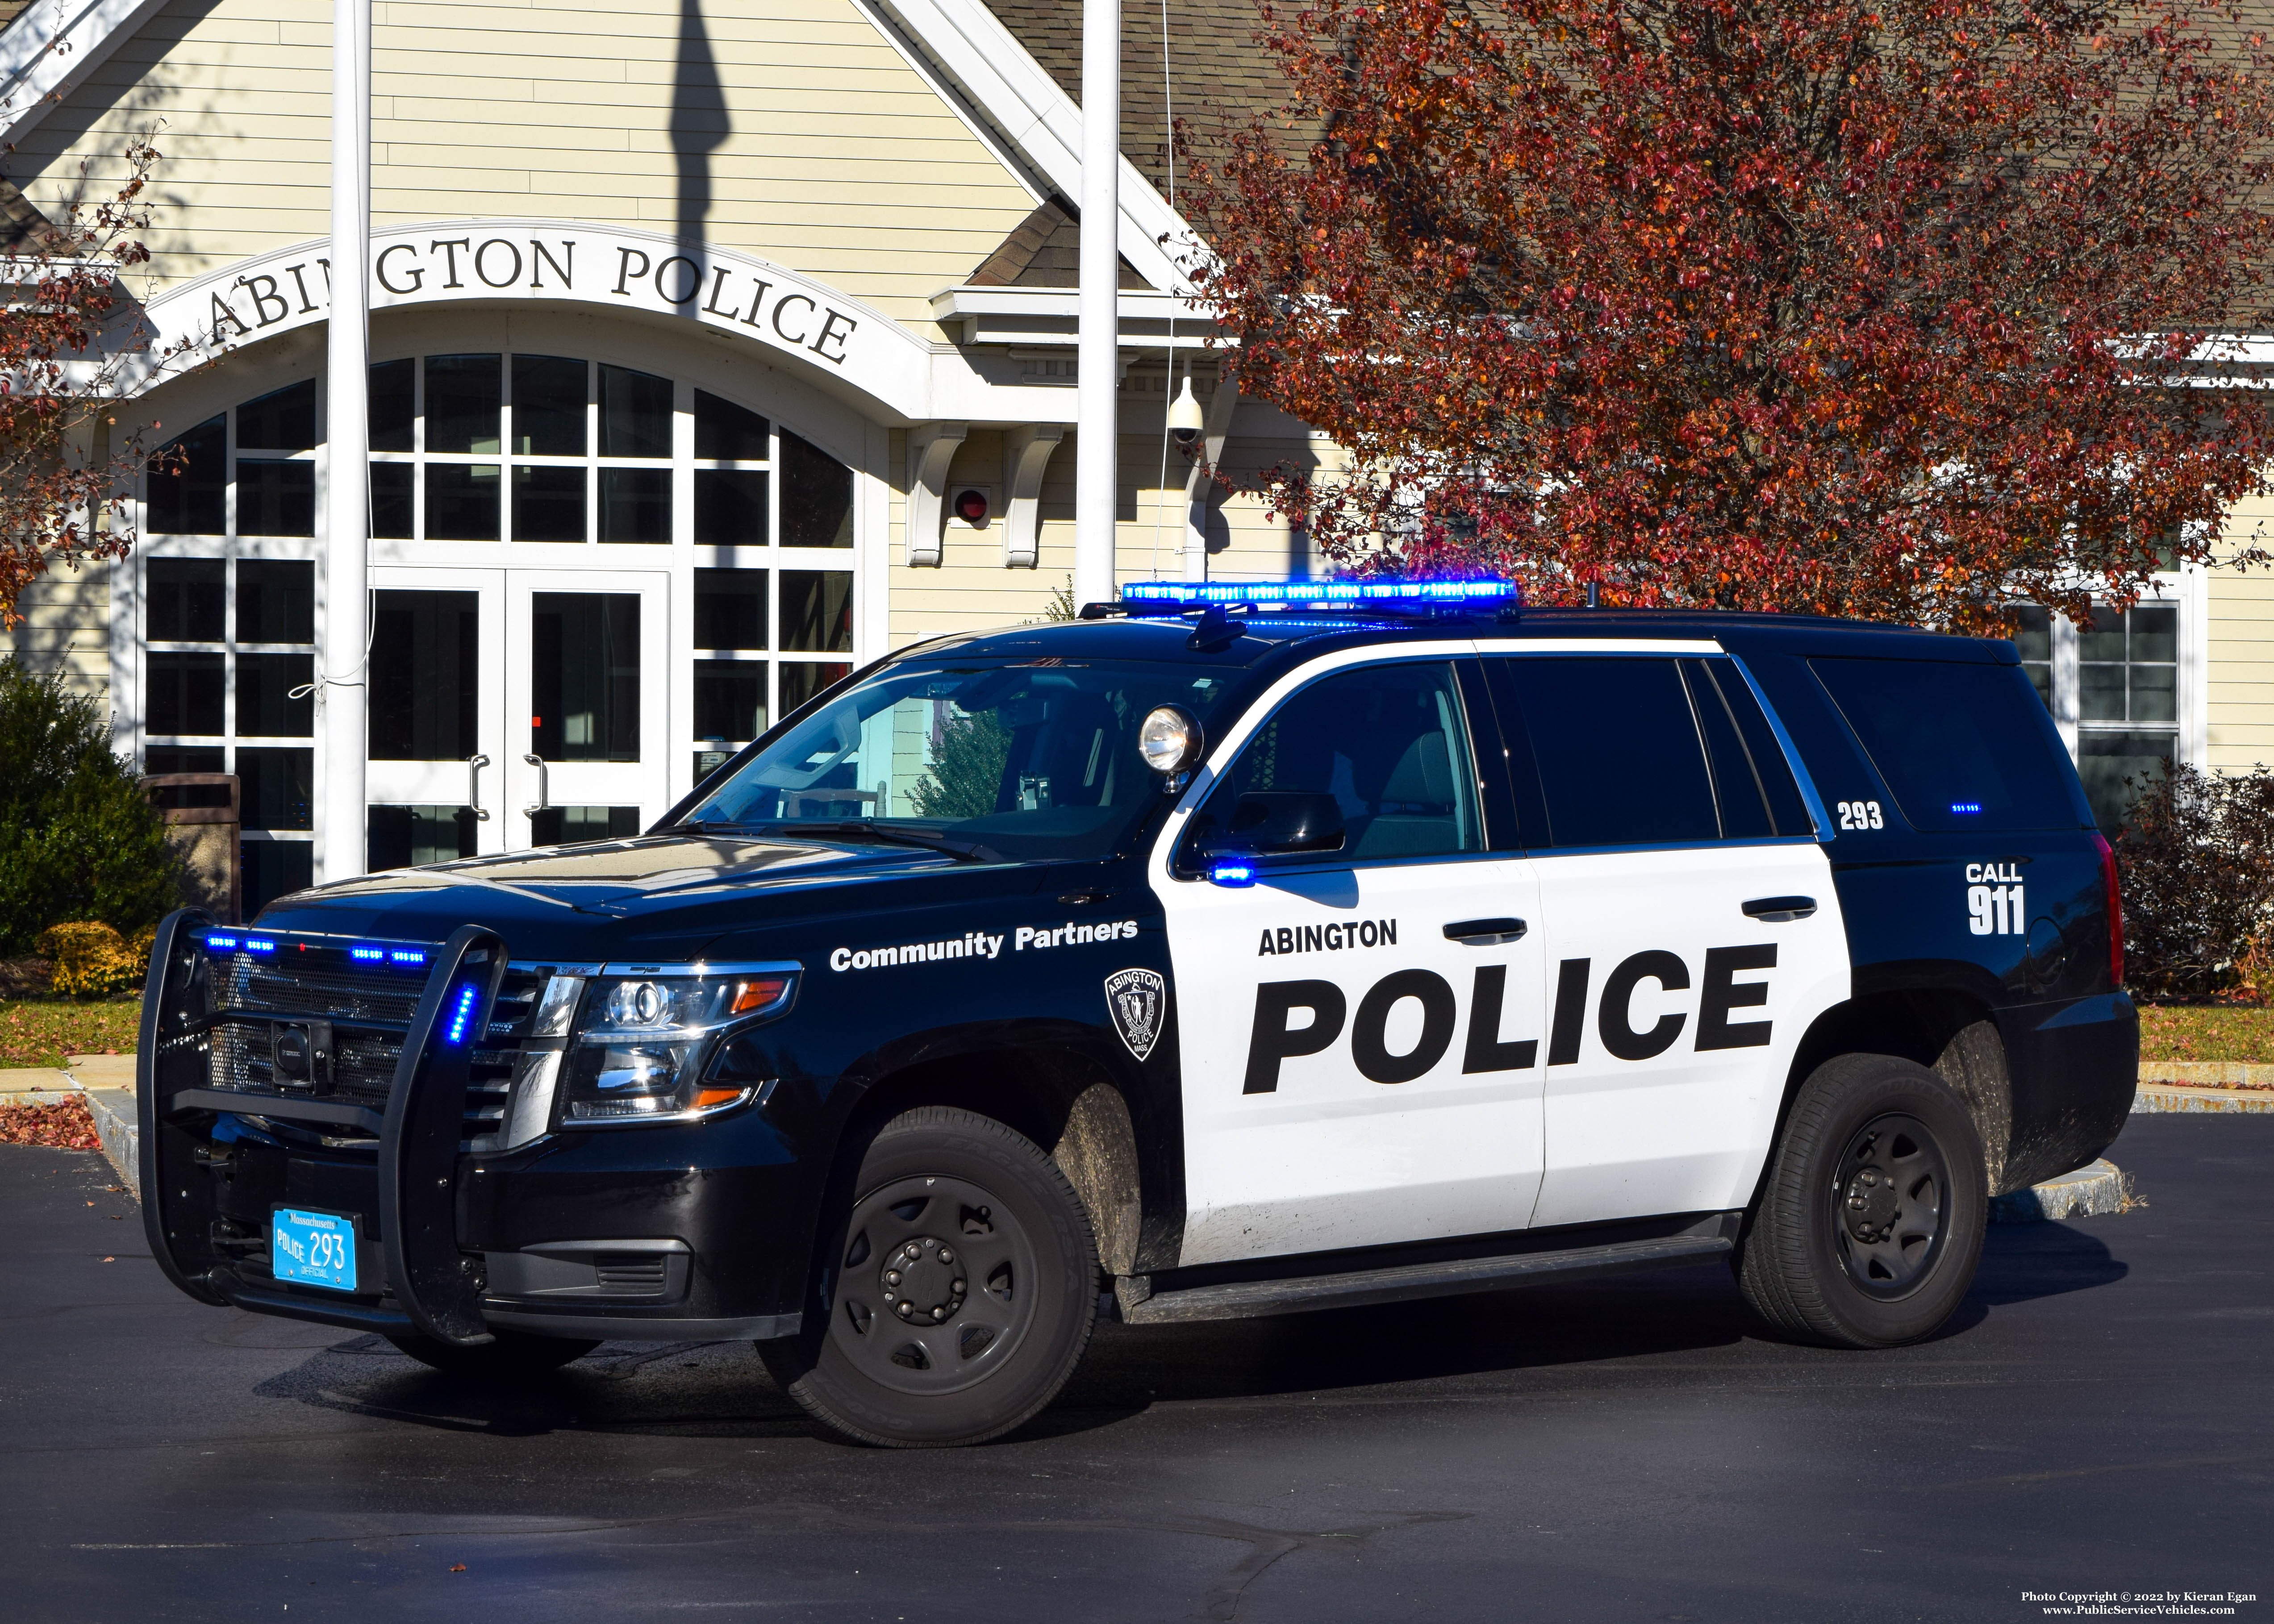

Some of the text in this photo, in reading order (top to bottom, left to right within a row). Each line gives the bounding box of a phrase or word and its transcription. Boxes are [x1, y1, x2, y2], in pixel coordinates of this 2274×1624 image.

[210, 238, 857, 364] ABIGTON POLICE
[1838, 802, 1883, 829] 293
[1966, 863, 2022, 883] CALL
[1968, 886, 2024, 935] 911
[830, 921, 1137, 971] Community Partners
[1259, 919, 1396, 956] ABINGTON
[1109, 971, 1160, 995] ABINGTON
[1243, 943, 1777, 1095] POLICE
[1127, 1028, 1153, 1044] POLICE
[290, 1213, 335, 1230] Massachusetts
[277, 1228, 344, 1270] POLICE 293
[301, 1266, 328, 1278] OFFICIAL
